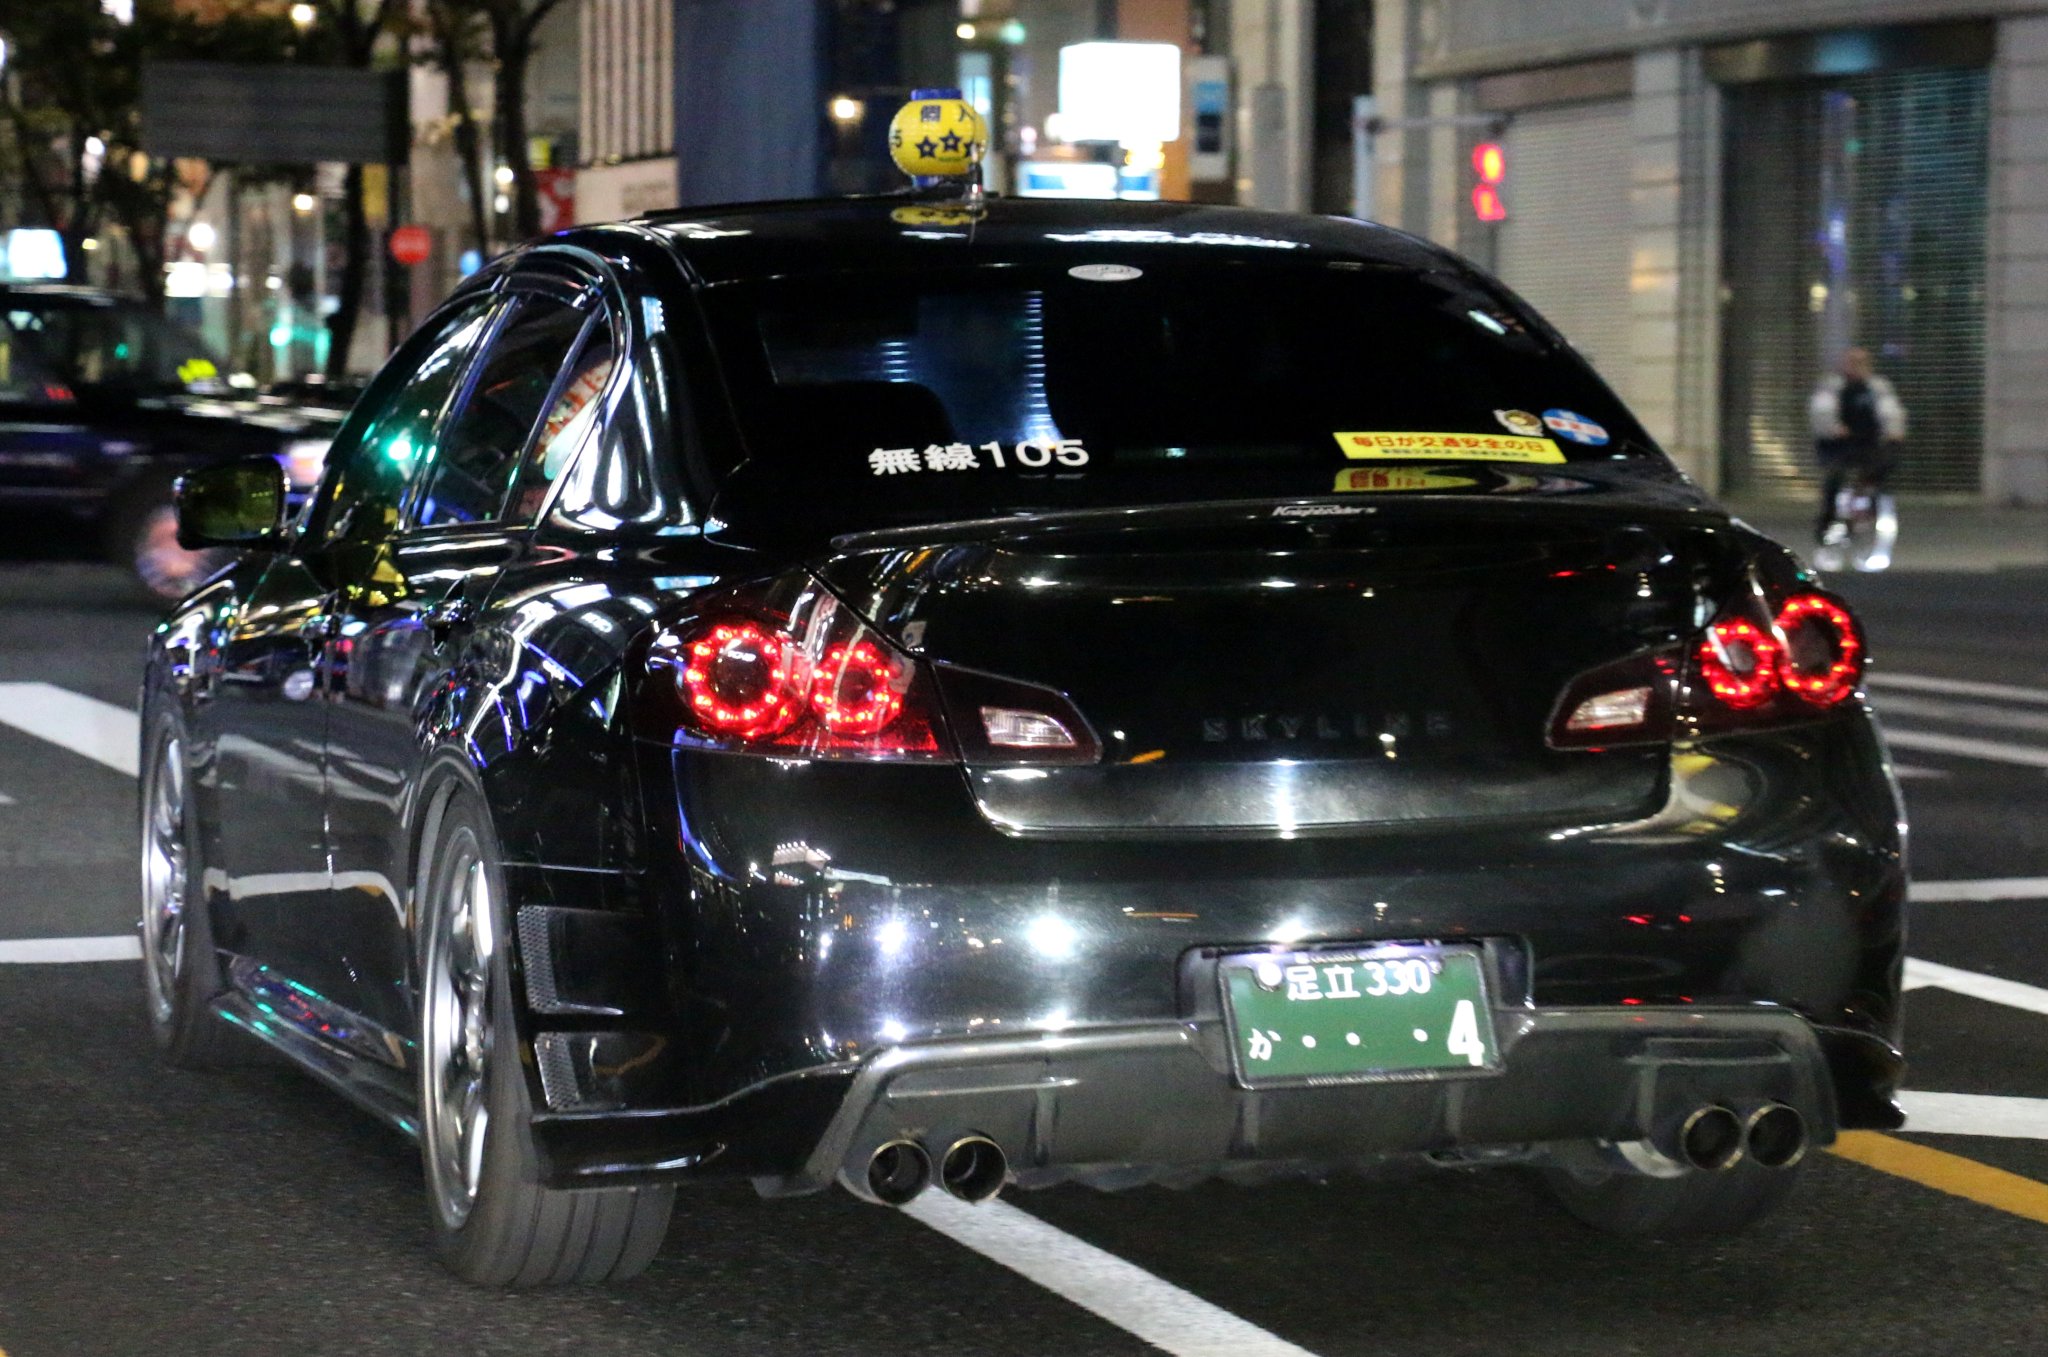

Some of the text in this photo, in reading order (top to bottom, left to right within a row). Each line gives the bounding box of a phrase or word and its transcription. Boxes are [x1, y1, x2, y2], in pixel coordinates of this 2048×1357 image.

[868, 439, 1090, 476] 無線105
[1286, 958, 1432, 1001] 足立 330
